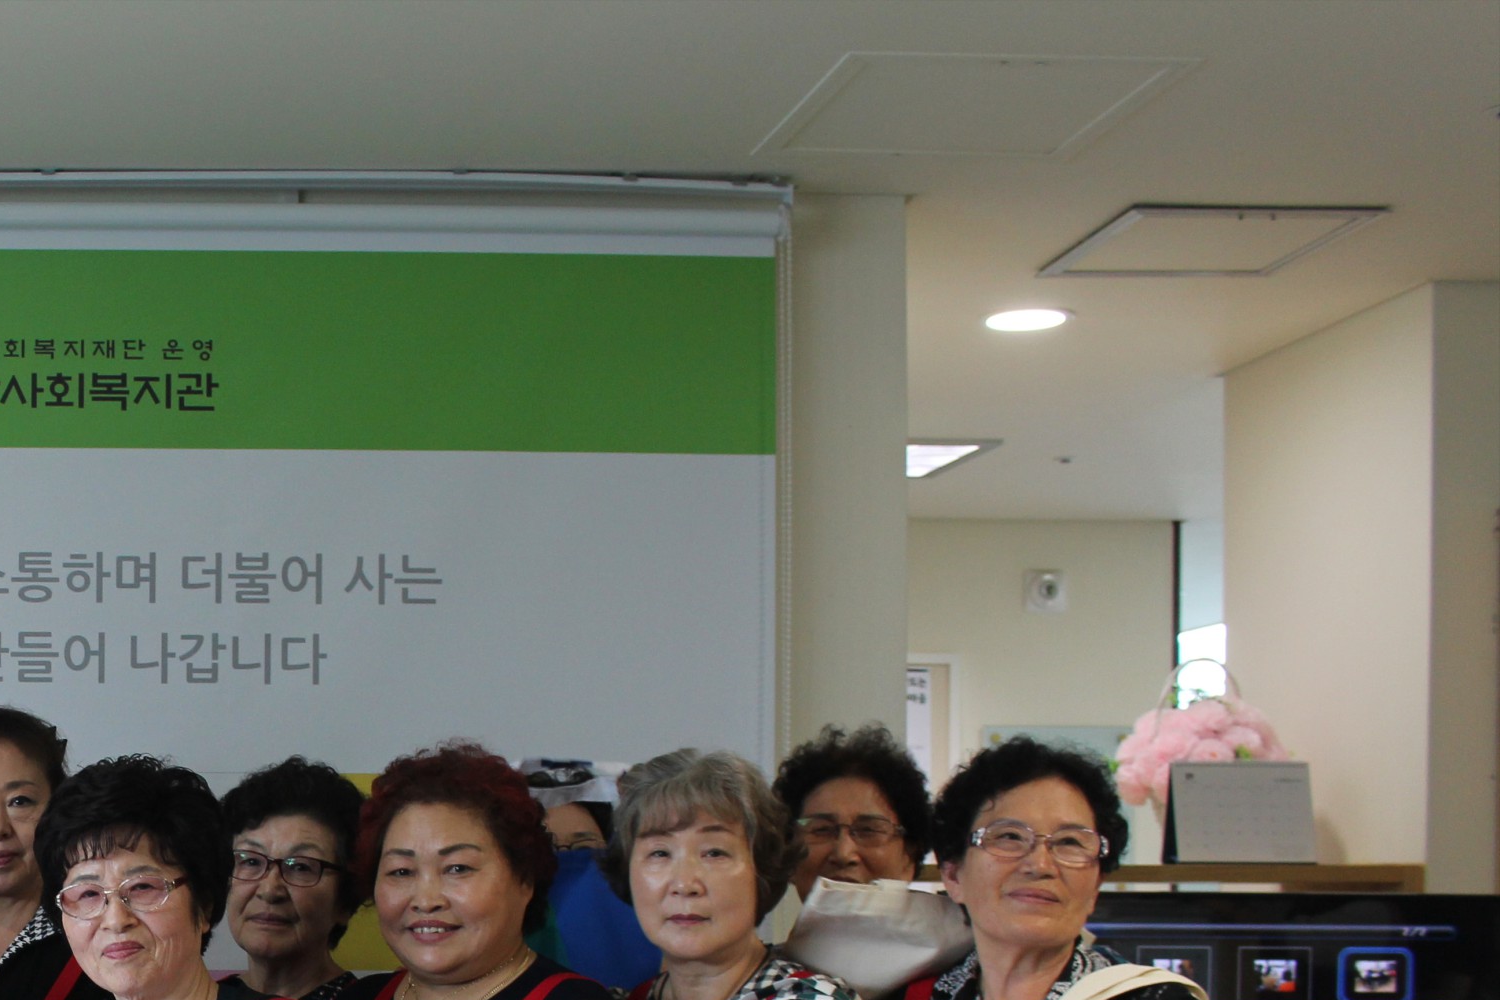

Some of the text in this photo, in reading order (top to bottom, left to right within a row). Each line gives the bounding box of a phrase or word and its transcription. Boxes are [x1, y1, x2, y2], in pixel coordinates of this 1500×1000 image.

[161, 339, 213, 361] 운영
[181, 552, 323, 604] 더불어
[344, 553, 442, 605] 사는
[130, 632, 328, 685] 나갑니다
